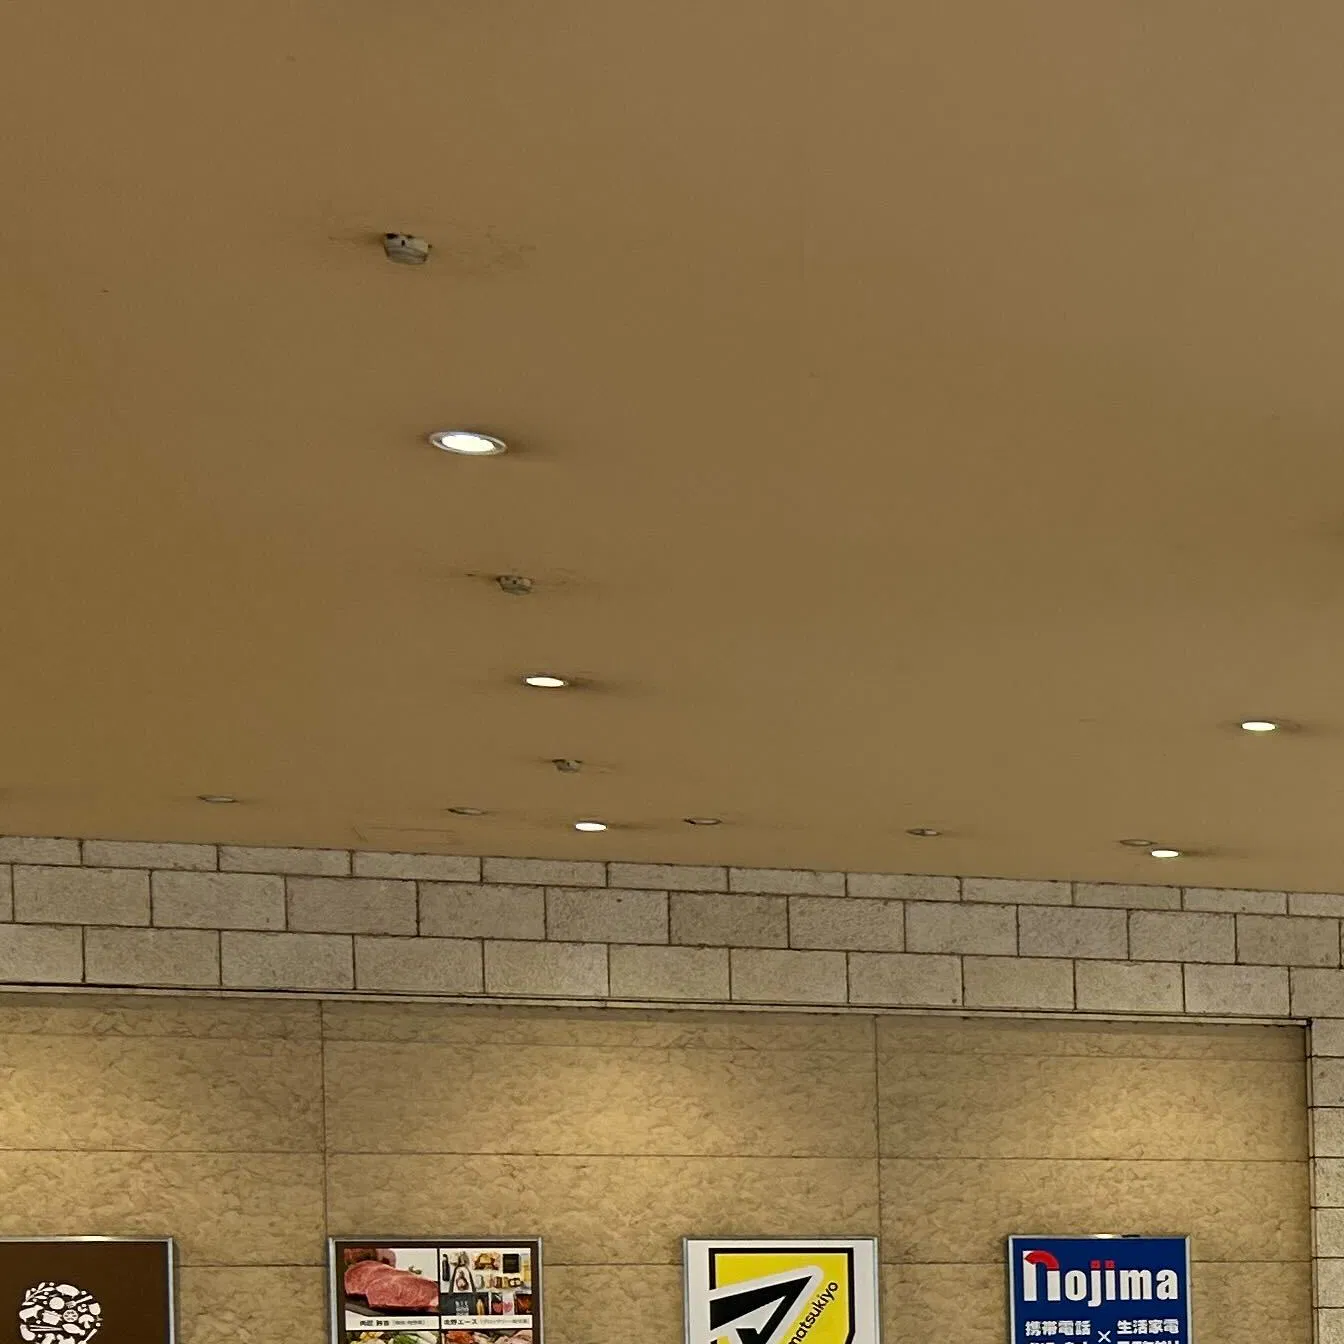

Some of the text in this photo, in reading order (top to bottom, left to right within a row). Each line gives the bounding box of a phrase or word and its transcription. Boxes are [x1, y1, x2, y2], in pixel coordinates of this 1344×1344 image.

[1022, 1250, 1178, 1307] nojima
[1024, 1320, 1091, 1337] 携帯電話
[1117, 1318, 1179, 1335] 生活家電
